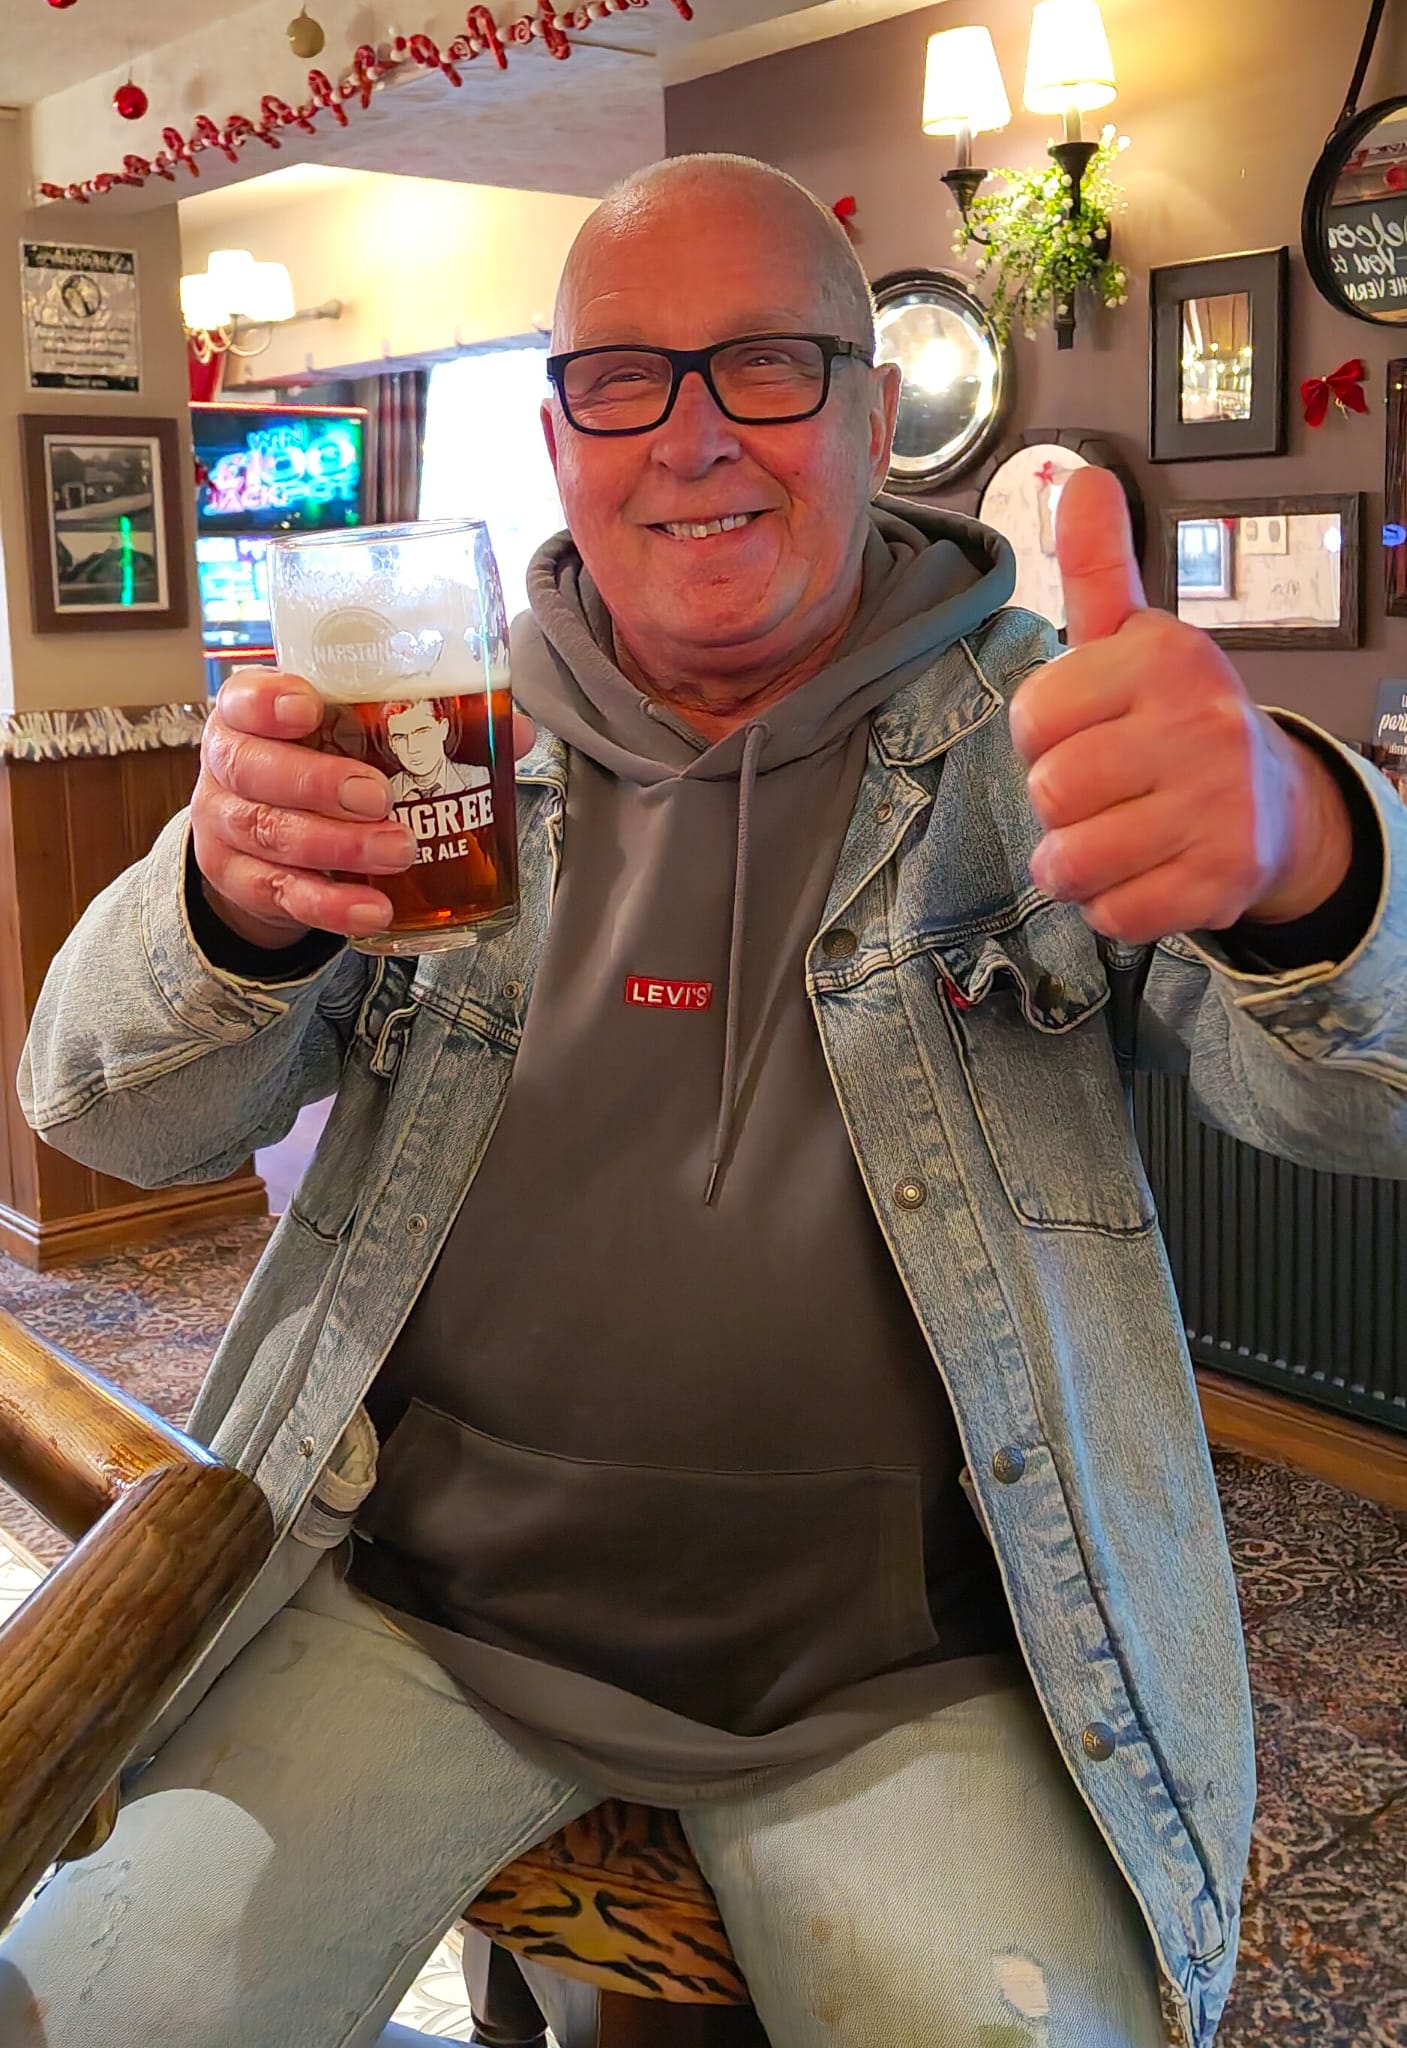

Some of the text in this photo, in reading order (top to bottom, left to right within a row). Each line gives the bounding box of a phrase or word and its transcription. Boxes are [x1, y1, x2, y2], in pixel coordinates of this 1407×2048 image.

[247, 423, 308, 450] WIN
[313, 639, 393, 664] MARSTON
[413, 839, 469, 865] ER ALE
[632, 982, 707, 1007] LEVI'S
